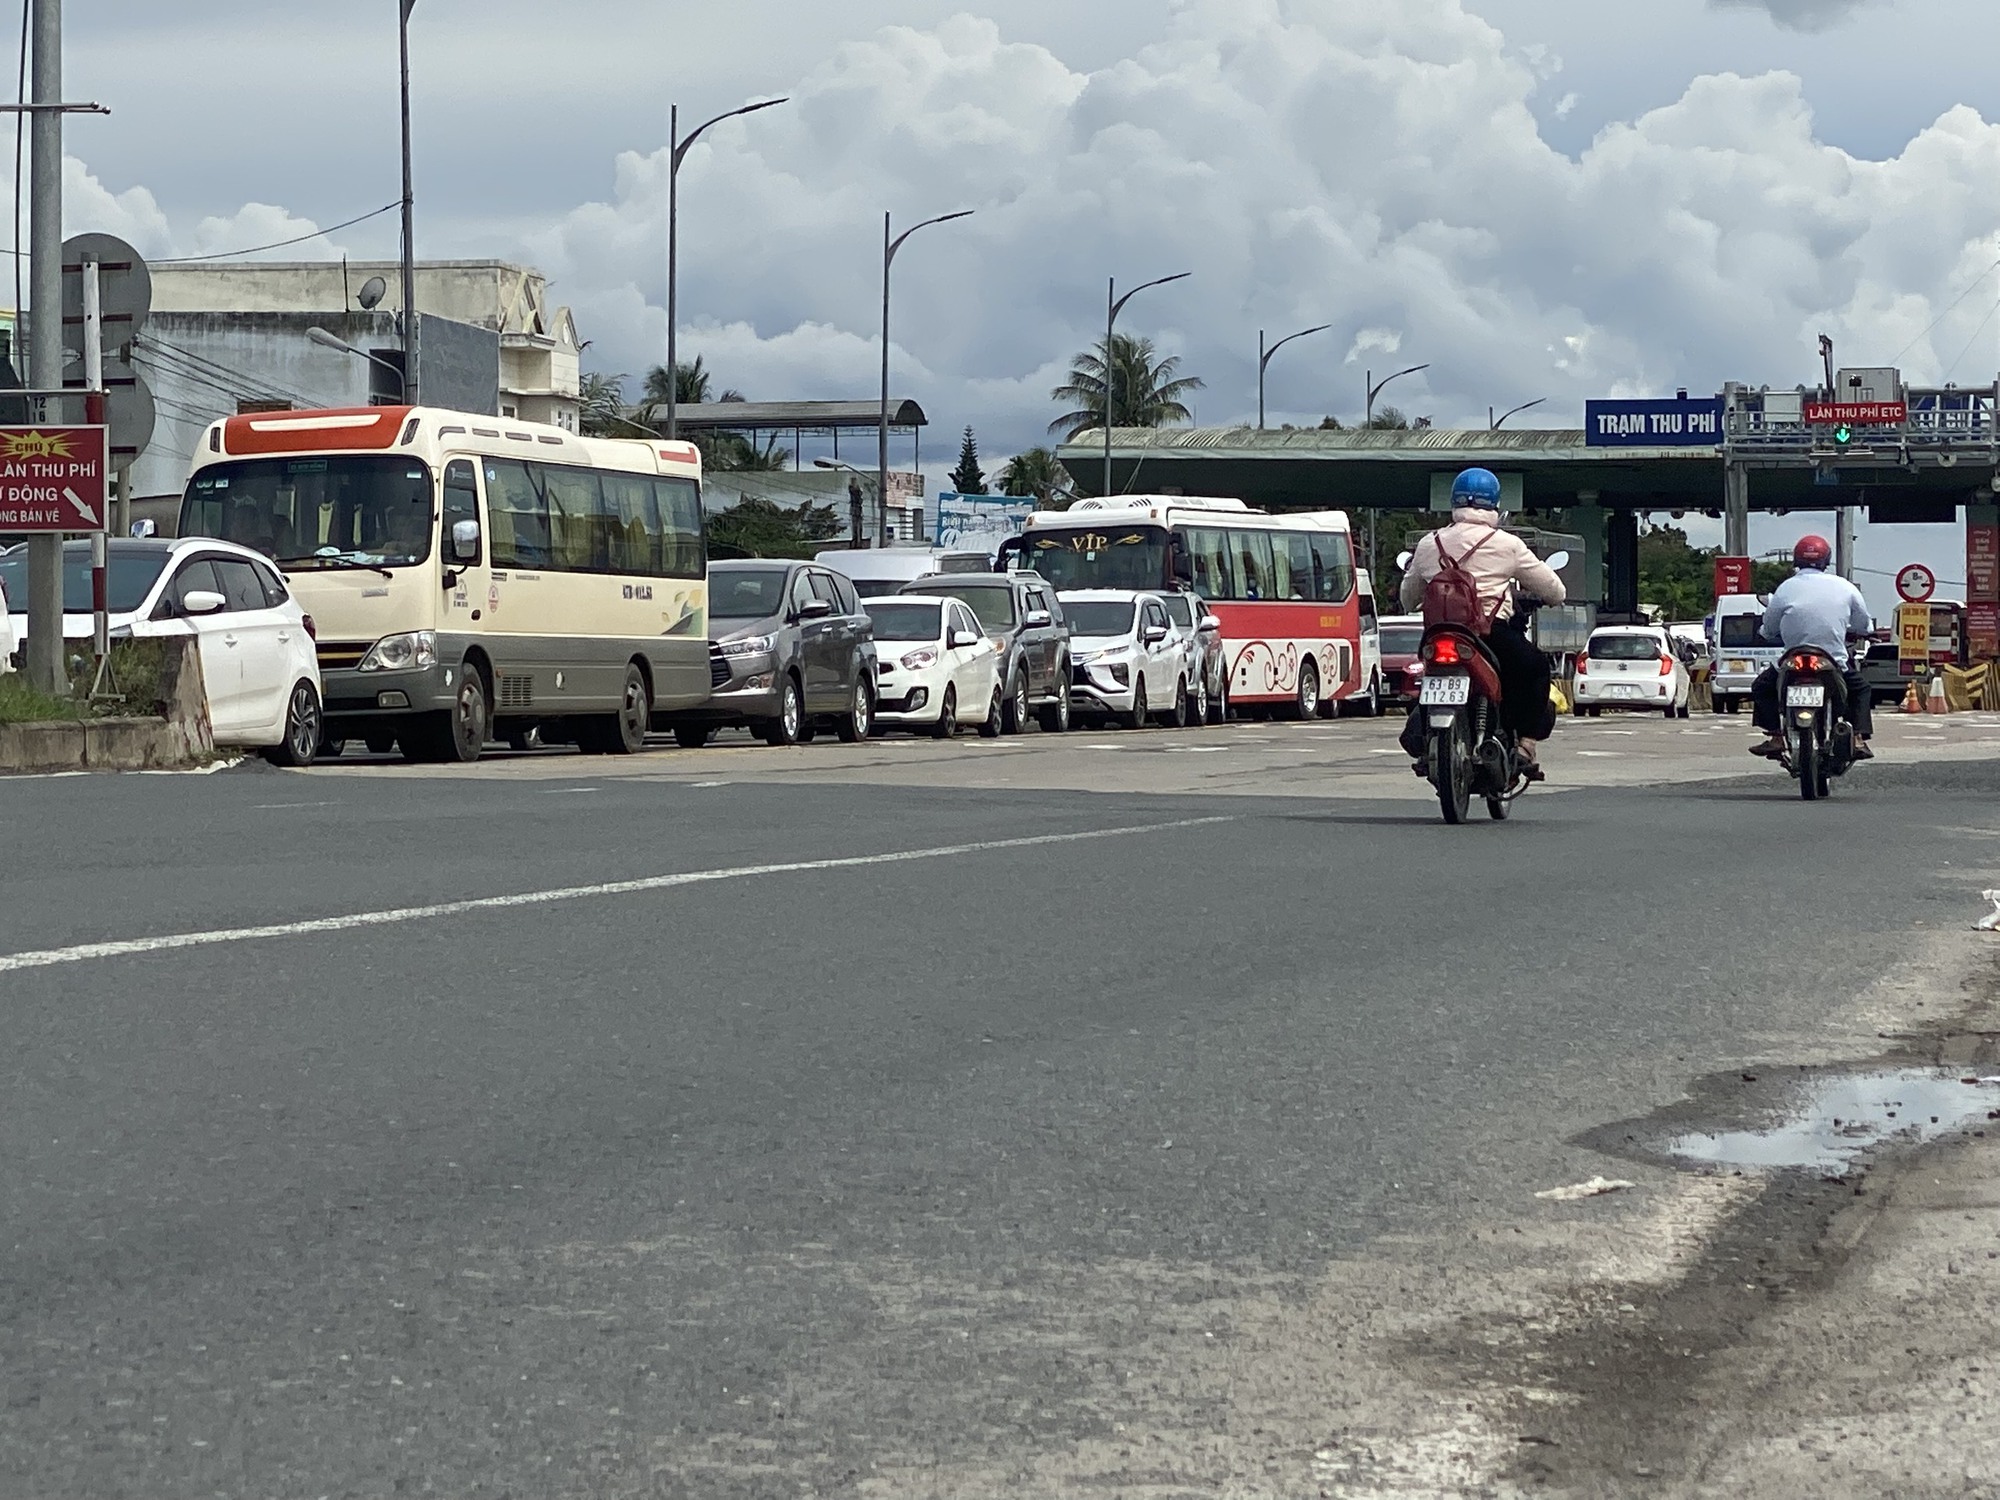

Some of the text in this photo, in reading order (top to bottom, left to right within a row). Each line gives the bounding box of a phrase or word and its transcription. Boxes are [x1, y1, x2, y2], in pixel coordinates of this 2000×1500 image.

[1809, 406, 1832, 419] LÀN
[1834, 407, 1857, 418] THU
[1860, 405, 1879, 418] PHÍ
[1881, 406, 1902, 418] ETC
[1597, 413, 1646, 437] TRẠM
[1650, 413, 1682, 433] THU
[1687, 409, 1716, 433] PHÍ
[15, 441, 43, 452] CHÚ
[31, 463, 63, 478] THU
[69, 460, 96, 478] PHÍ
[8, 484, 58, 505] ĐỘNG
[0, 510, 17, 523] NG
[20, 507, 42, 523] BÁN
[1072, 534, 1108, 551] VIP
[1904, 624, 1925, 640] ETC
